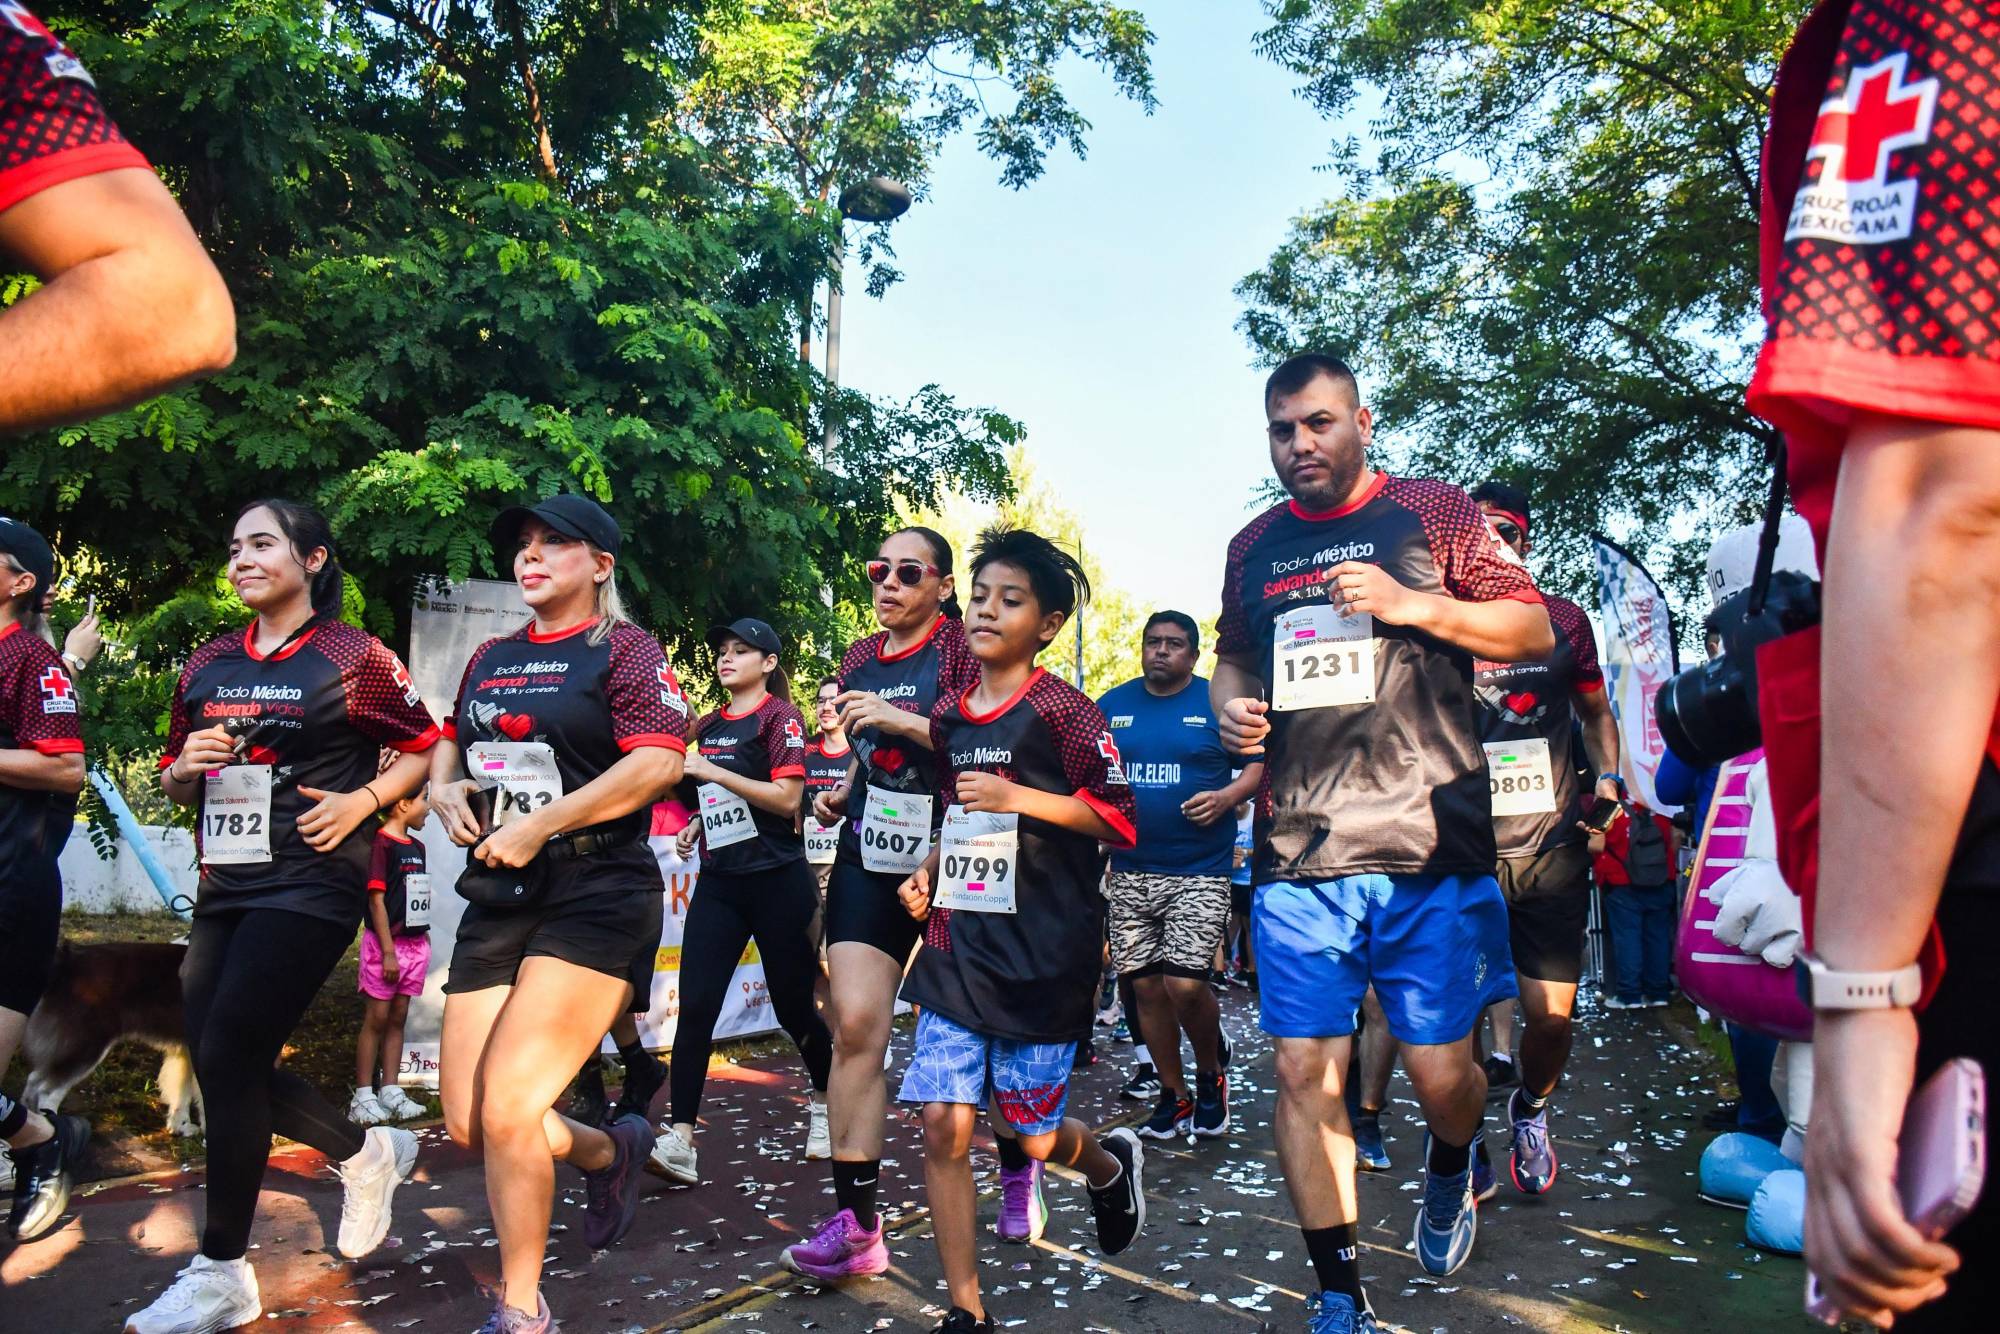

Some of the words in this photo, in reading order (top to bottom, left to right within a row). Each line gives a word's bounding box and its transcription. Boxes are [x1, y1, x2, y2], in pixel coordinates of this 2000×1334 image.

[1851, 192, 1902, 214] ROJA
[1788, 215, 1899, 234] MEXICANA
[1272, 557, 1310, 575] Todo
[1312, 542, 1374, 564] México
[1306, 586, 1326, 598] 10k
[493, 665, 523, 676] Todo
[522, 661, 568, 674] México
[1284, 651, 1360, 682] 1231
[1495, 669, 1509, 677] 10k
[216, 686, 250, 698] Todo
[251, 685, 302, 700] México
[203, 701, 262, 717] Salvando
[266, 702, 305, 716] Vidas
[951, 750, 972, 766] Todo
[974, 746, 1011, 764] México
[205, 812, 263, 837] 1782
[706, 807, 747, 831] 0442
[865, 826, 923, 855] 0607
[945, 854, 1008, 882] 0799
[953, 891, 982, 902] Fundación
[984, 893, 1009, 904] Coppel
